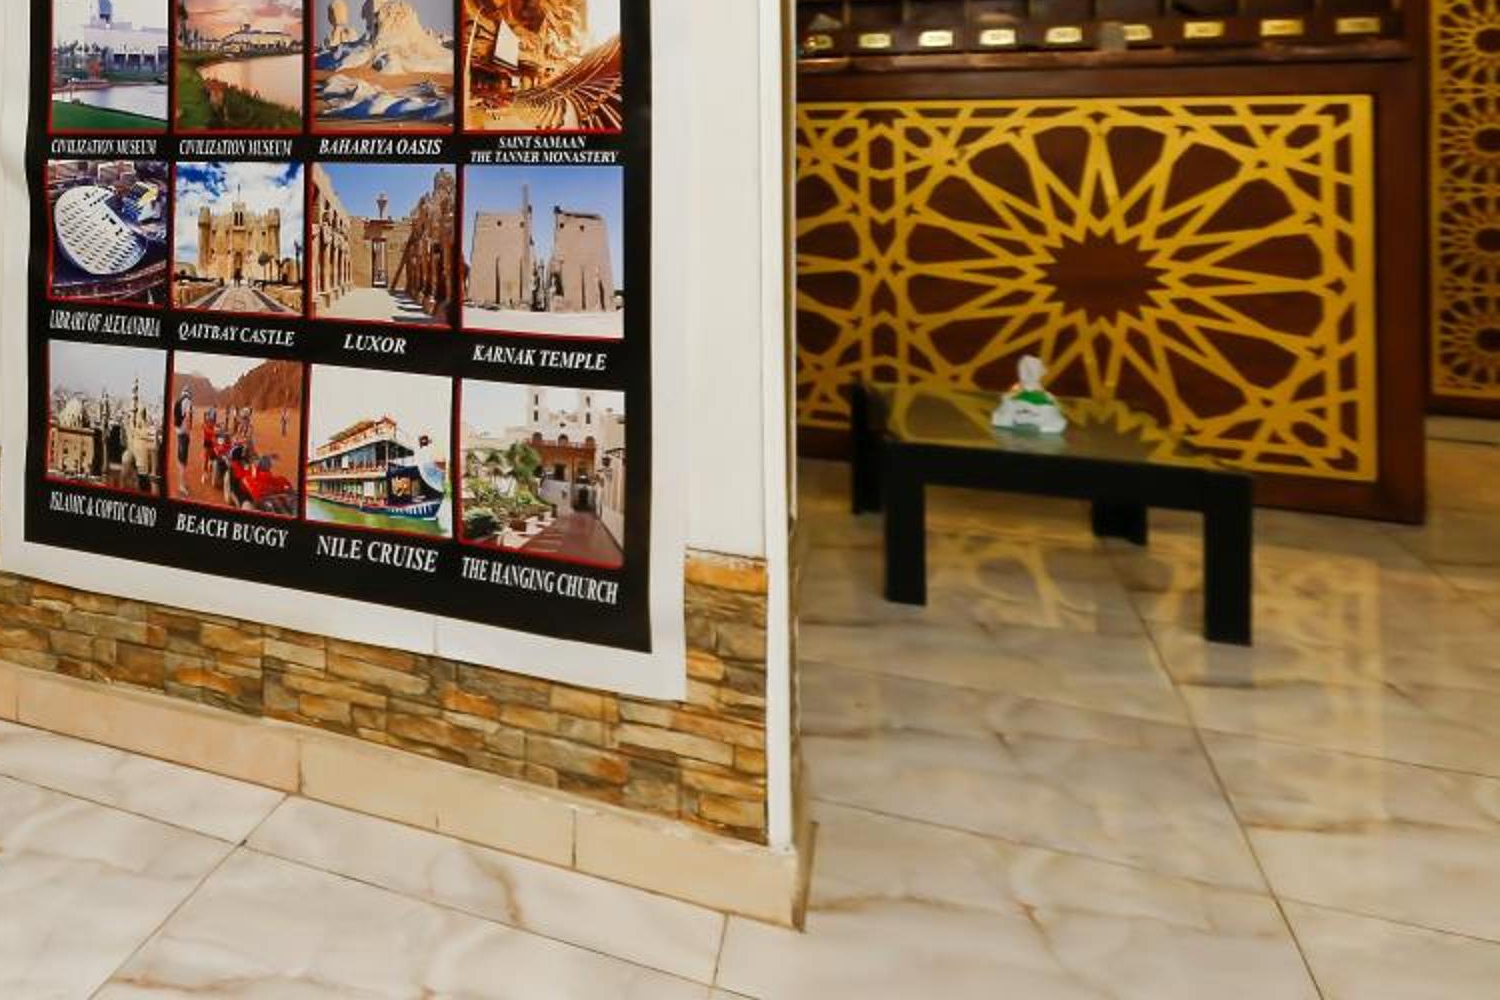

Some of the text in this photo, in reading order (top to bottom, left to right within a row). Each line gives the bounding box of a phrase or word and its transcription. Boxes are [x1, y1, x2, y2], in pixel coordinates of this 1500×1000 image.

[319, 138, 443, 155] BAHARIYA OASIS
[499, 135, 587, 150] SAINT SAMAAN
[471, 151, 619, 164] THE TANNER MONASTERY
[50, 309, 87, 330] LIBRARY
[87, 313, 102, 332] OF
[179, 322, 295, 347] QAITBAY CASTLE
[344, 333, 407, 355] LUXOR
[472, 344, 608, 371] KARNAK TEMPLE
[176, 513, 289, 549] BEACH BUGGY
[316, 535, 440, 573] NILE CRUISE
[461, 556, 620, 605] THE HANGING CHURCH
